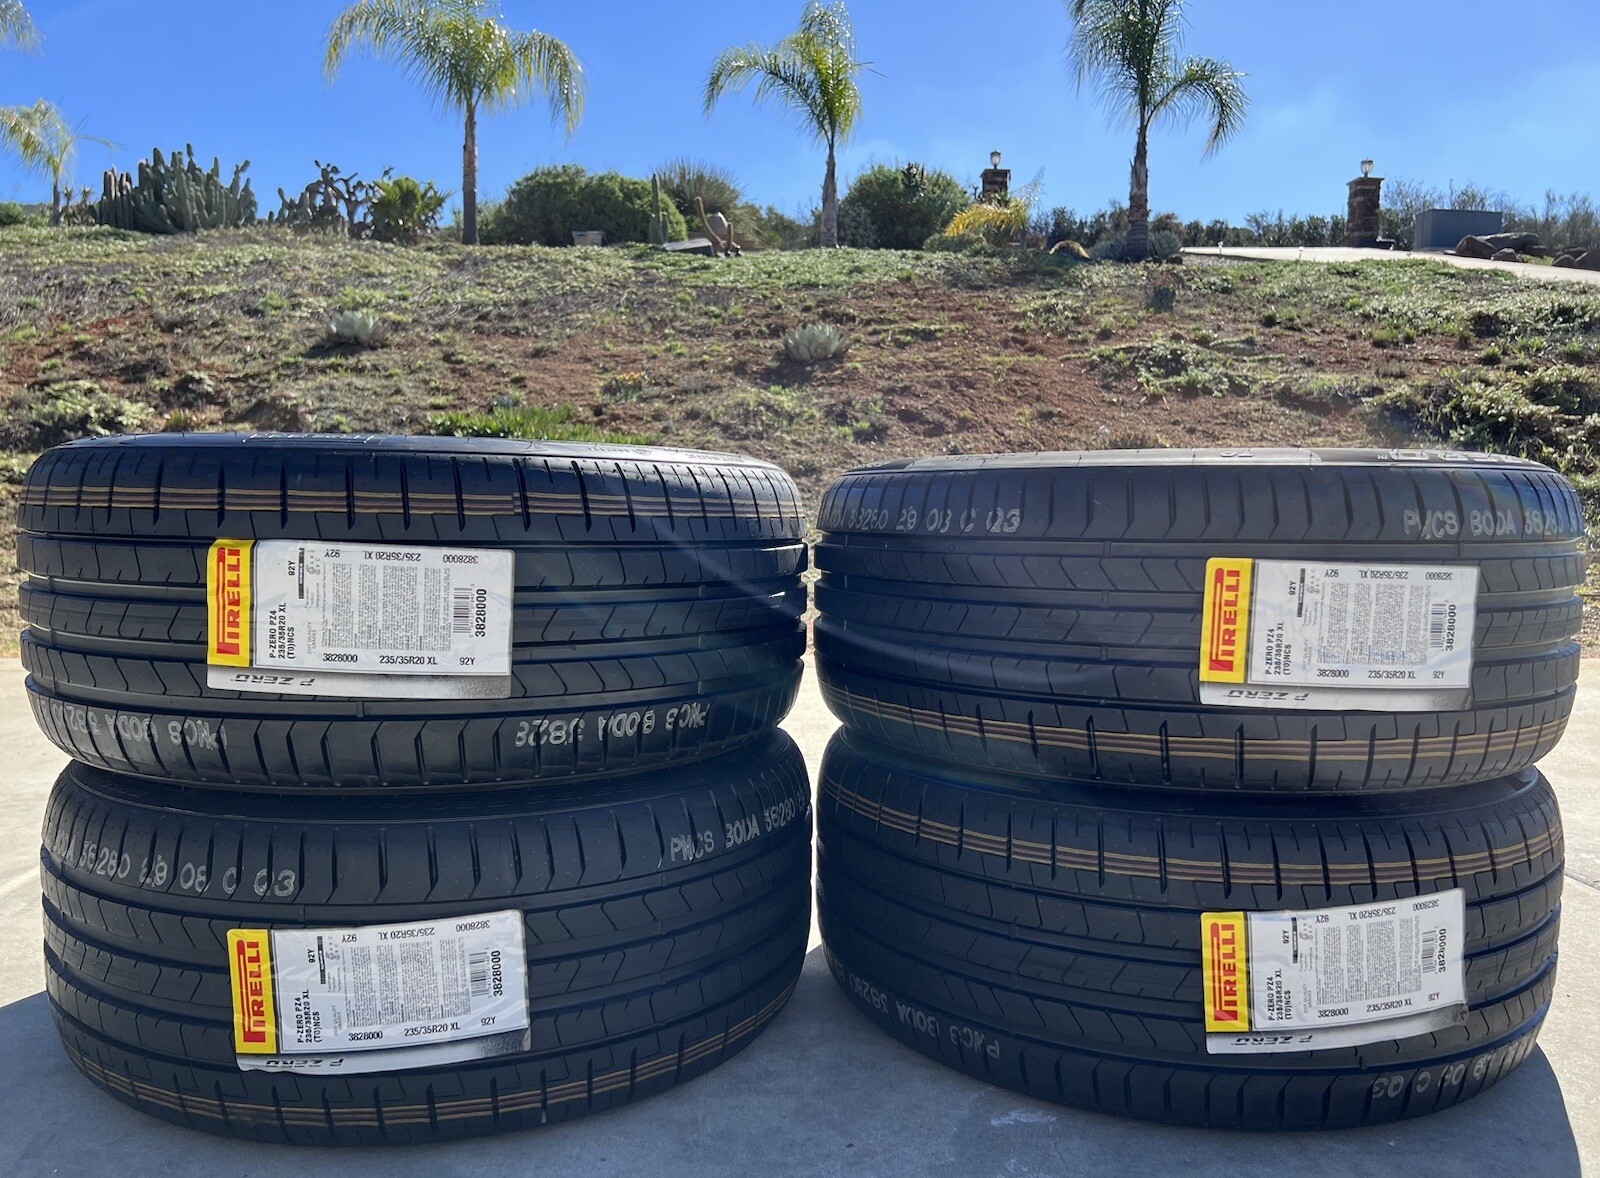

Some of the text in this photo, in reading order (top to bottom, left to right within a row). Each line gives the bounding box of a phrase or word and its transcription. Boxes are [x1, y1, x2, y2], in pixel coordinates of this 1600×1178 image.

[324, 549, 340, 558] 92Y
[363, 551, 373, 560] XL
[1324, 569, 1339, 577] 92Y
[1359, 570, 1368, 578] XL
[1288, 580, 1296, 596] 92Y
[216, 546, 240, 655] PIRELLI
[279, 602, 286, 612] XL
[475, 589, 486, 637] 3828000
[1209, 567, 1240, 672] PIRELLI
[1276, 621, 1284, 631] XL
[1445, 604, 1456, 651] 3828000
[322, 653, 475, 666] 3828000 235/35R20 XL 92Y
[1317, 668, 1444, 680] 3828000 235/35R20 XL 92Y
[1315, 914, 1329, 923] 92Y
[1348, 912, 1357, 920] XL
[341, 934, 357, 942] 92Y
[378, 932, 388, 940] XL
[1282, 930, 1290, 944] 92Y
[1438, 928, 1446, 973] 3828000
[491, 950, 503, 996] 3828000
[1211, 922, 1238, 1022] PIRELLI
[1275, 968, 1282, 978] XL
[238, 939, 266, 1043] PIRELLI
[302, 989, 310, 999] XL
[1317, 992, 1440, 1018] 3828000 235/35R20 XL 92Y
[348, 1017, 496, 1041] 3828000 235/35R20 XL 92Y
